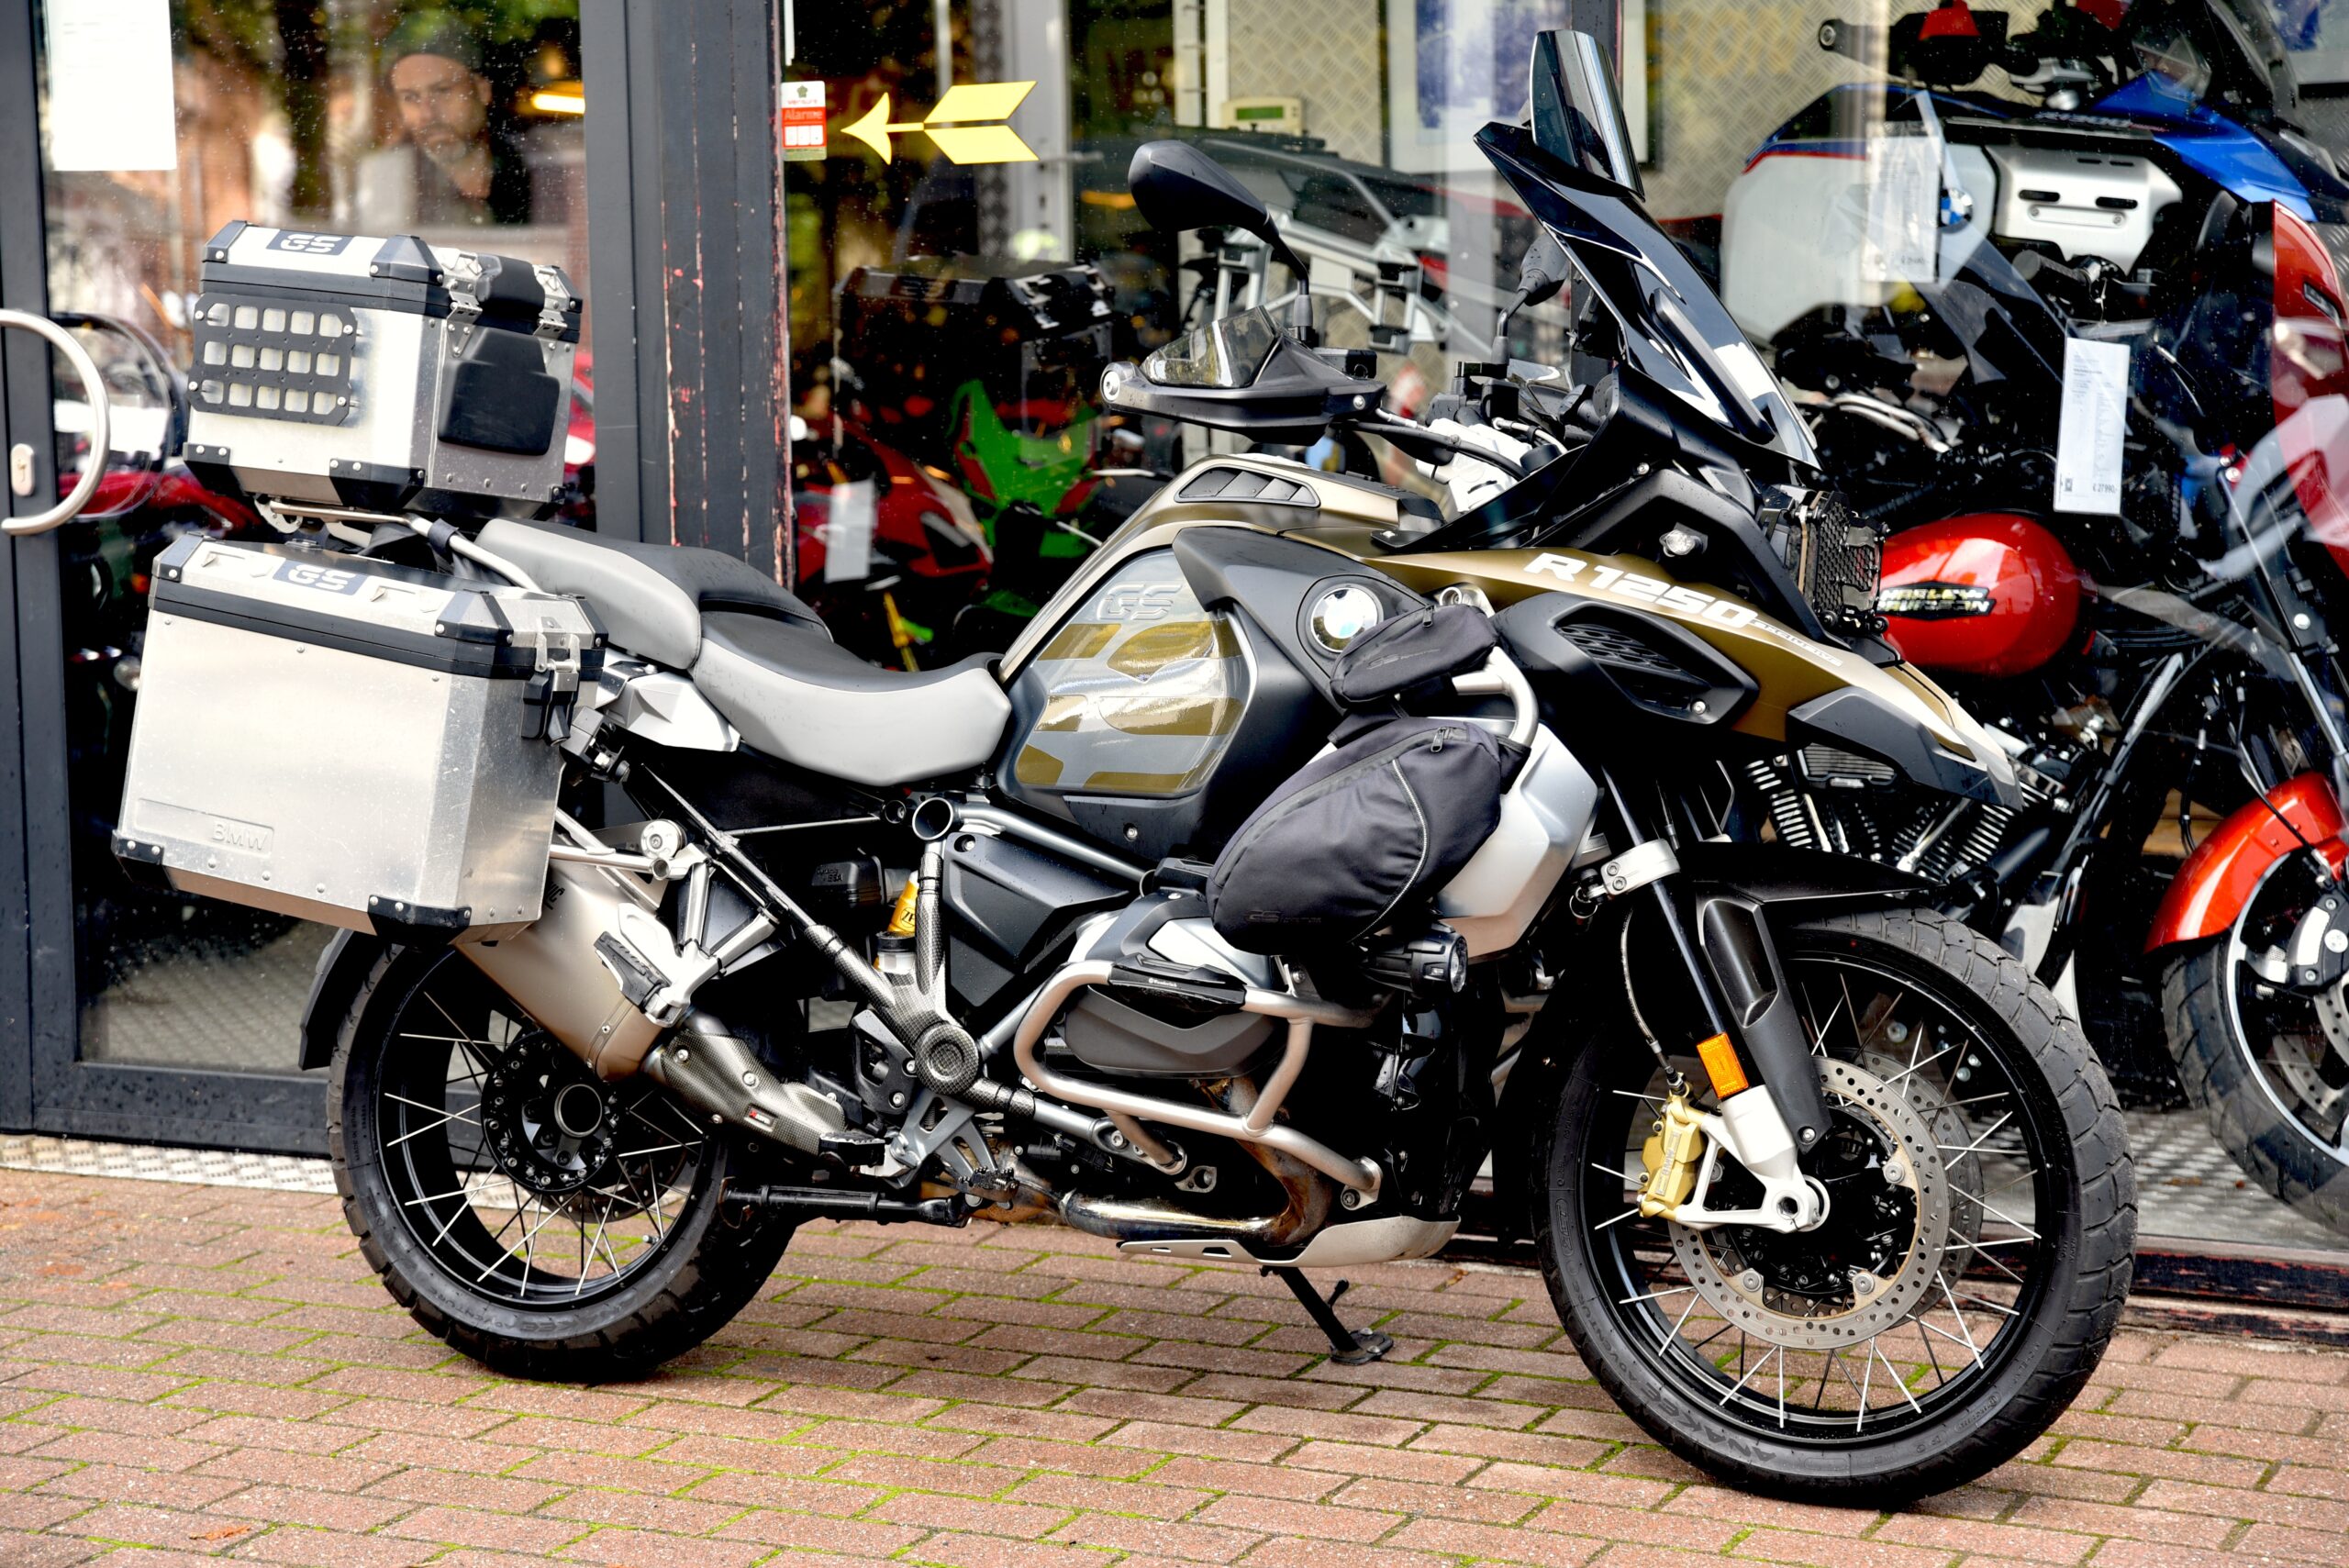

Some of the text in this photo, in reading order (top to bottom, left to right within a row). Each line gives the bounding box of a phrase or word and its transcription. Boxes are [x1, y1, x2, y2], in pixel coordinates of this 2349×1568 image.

[280, 233, 343, 253] GS
[287, 563, 357, 591] GS
[1523, 552, 1759, 628] R 1250
[1096, 583, 1183, 621] GS
[211, 822, 269, 851] BMW
[1572, 1281, 1776, 1462] ANAKEE ADVENTURE
